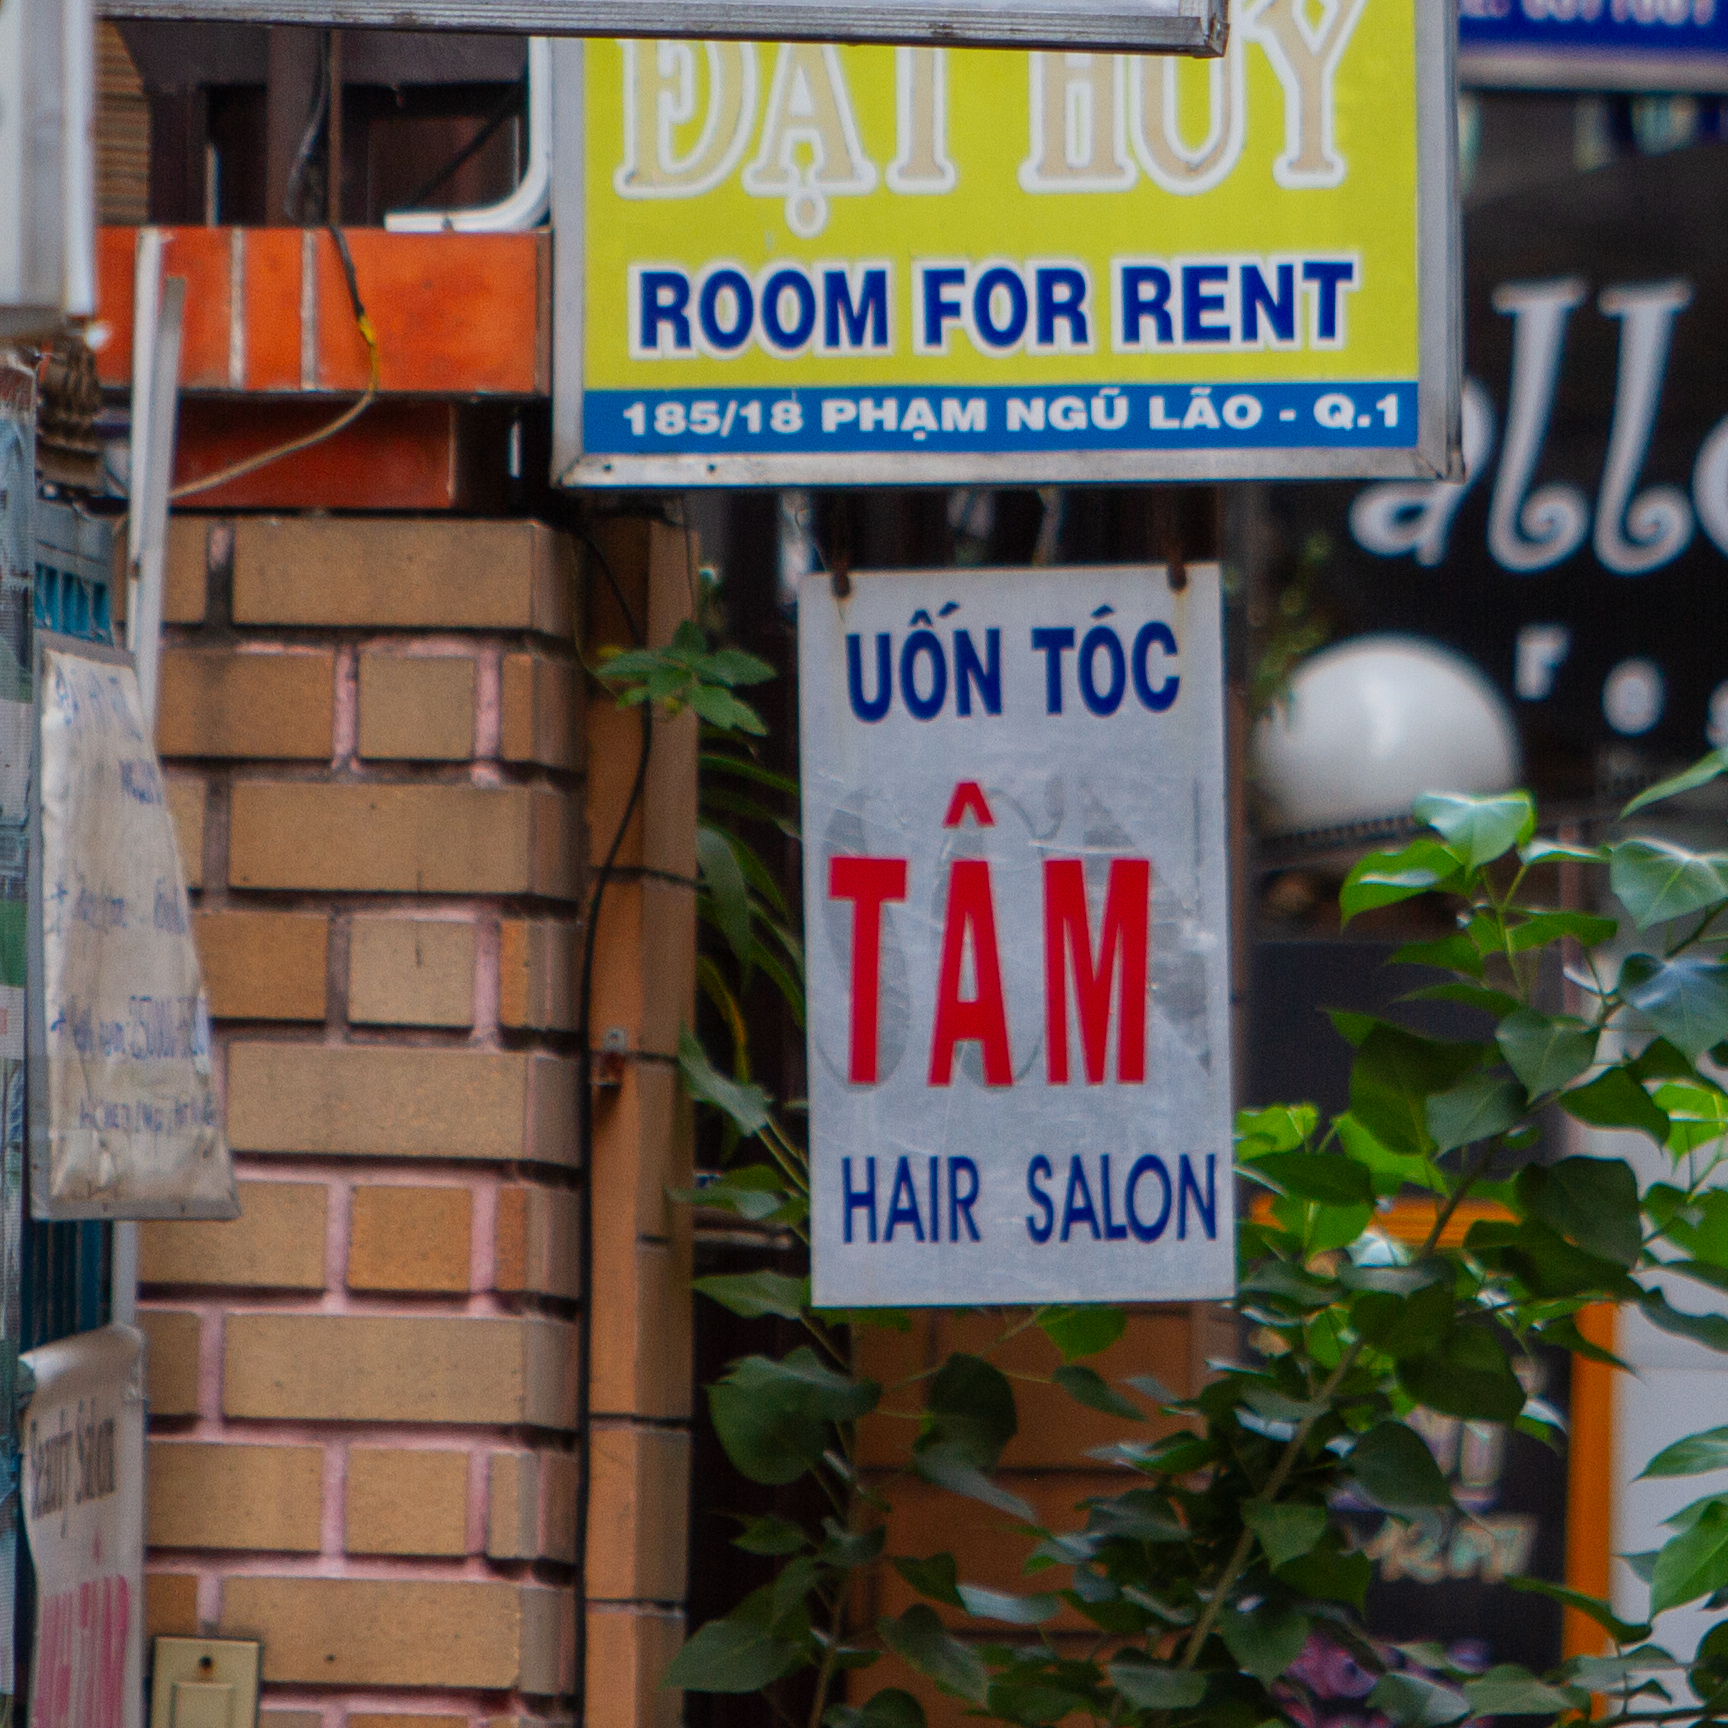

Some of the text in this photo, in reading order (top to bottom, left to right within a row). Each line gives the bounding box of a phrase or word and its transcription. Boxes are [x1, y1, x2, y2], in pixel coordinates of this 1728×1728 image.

[636, 258, 1358, 352] ROOM FOR RENT
[623, 399, 804, 438] 185/18
[822, 397, 988, 442] PHẠM
[1006, 388, 1129, 432] NGŨ
[1149, 386, 1263, 431] LÃO
[1313, 393, 1401, 431] Q.1
[845, 600, 1181, 723] UỐN TÓC
[827, 779, 1152, 1088] TÂM
[841, 1152, 1219, 1245] HAIR SALON
